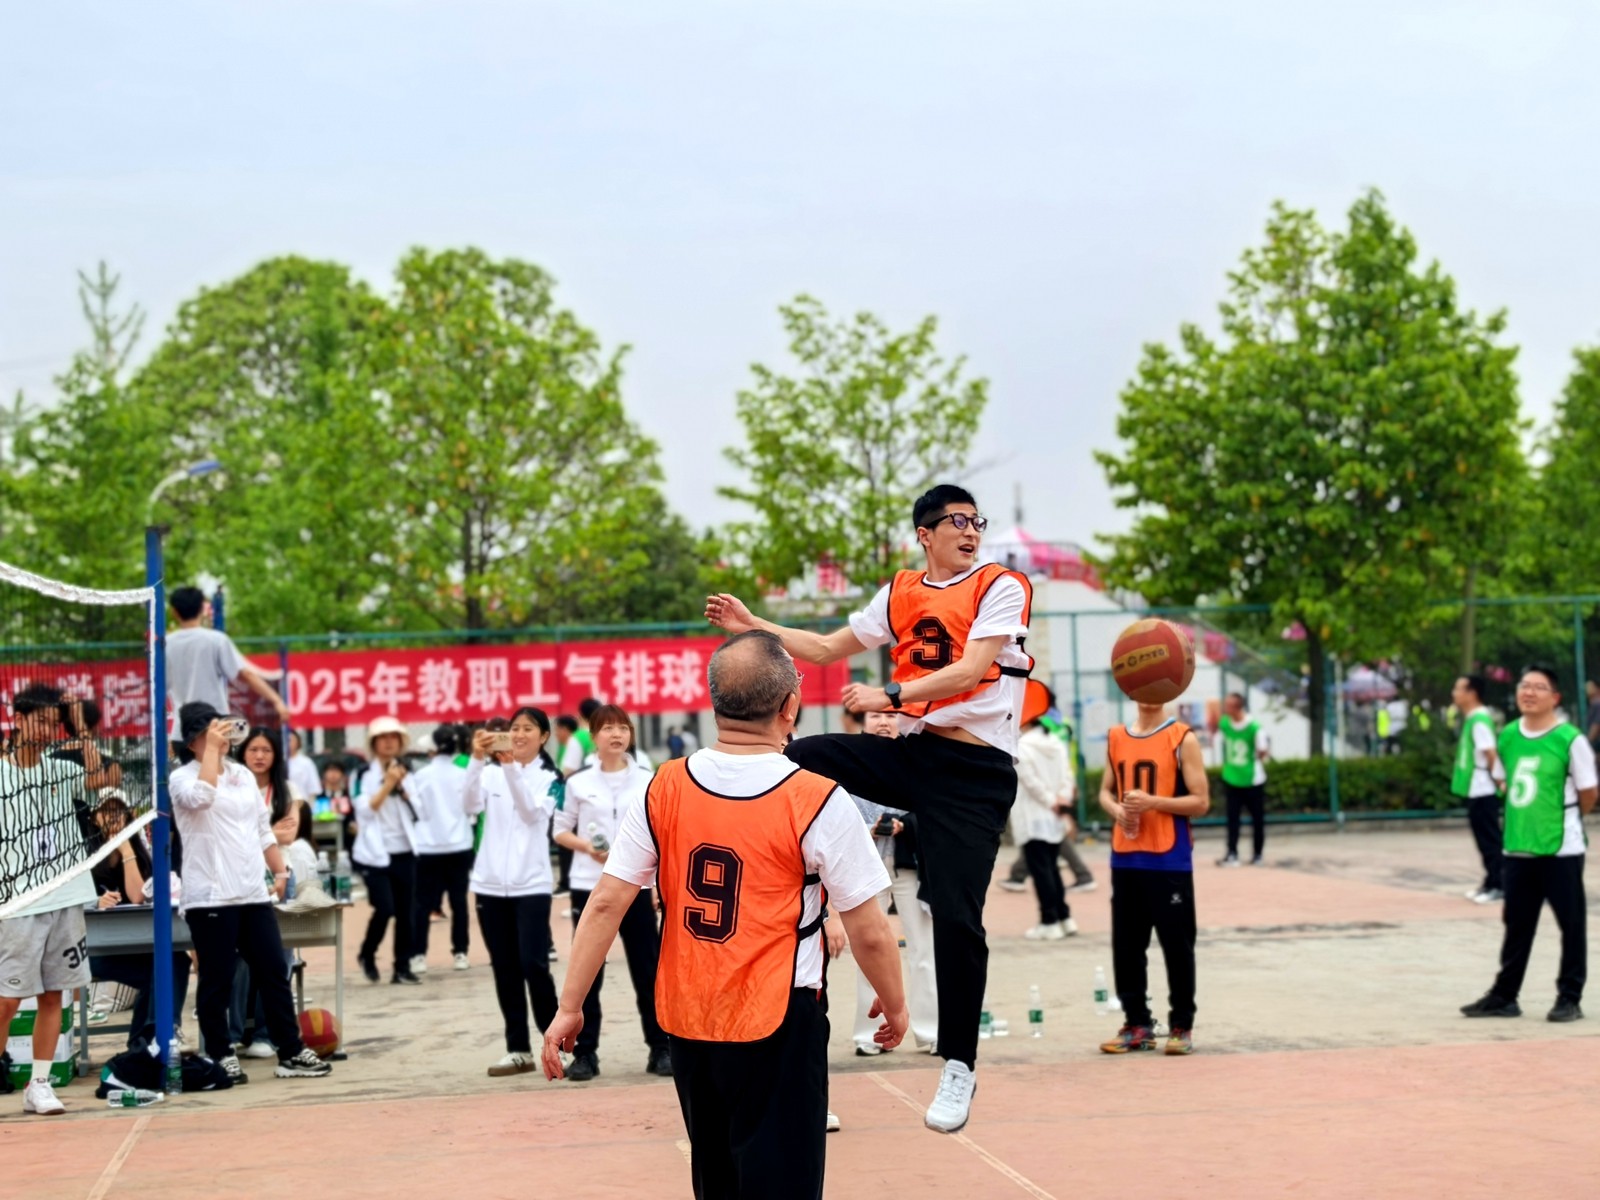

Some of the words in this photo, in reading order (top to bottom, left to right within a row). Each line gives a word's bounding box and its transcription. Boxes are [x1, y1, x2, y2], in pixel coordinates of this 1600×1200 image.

[910, 616, 952, 671] 3
[1117, 759, 1158, 803] 10
[1509, 755, 1541, 807] 5
[684, 842, 744, 944] 9
